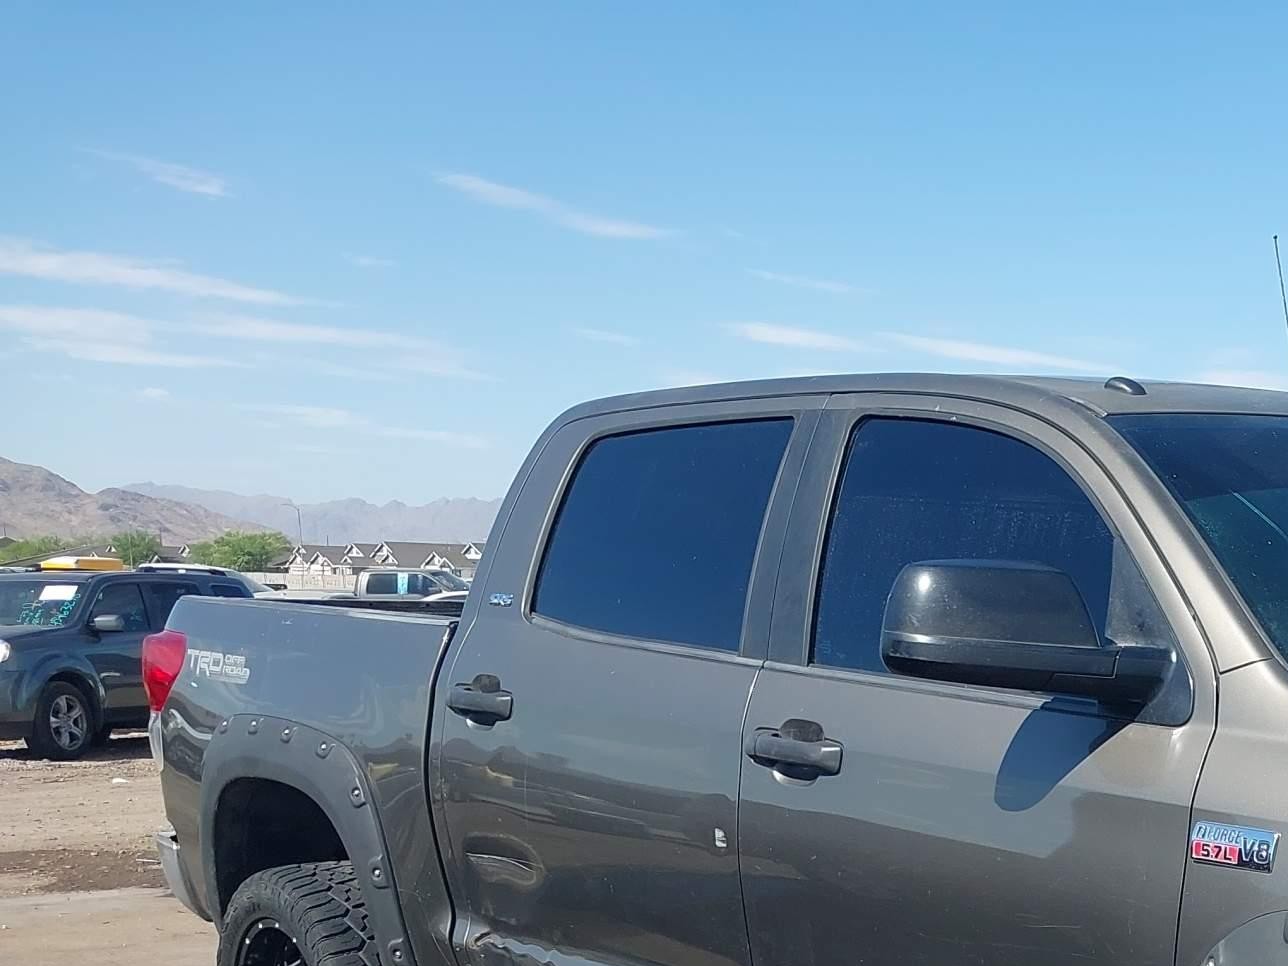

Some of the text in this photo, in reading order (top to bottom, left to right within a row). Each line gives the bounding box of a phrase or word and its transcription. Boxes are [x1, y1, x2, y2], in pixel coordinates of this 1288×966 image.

[187, 648, 224, 677] TRD
[1201, 836, 1272, 865] 5.7L V8
